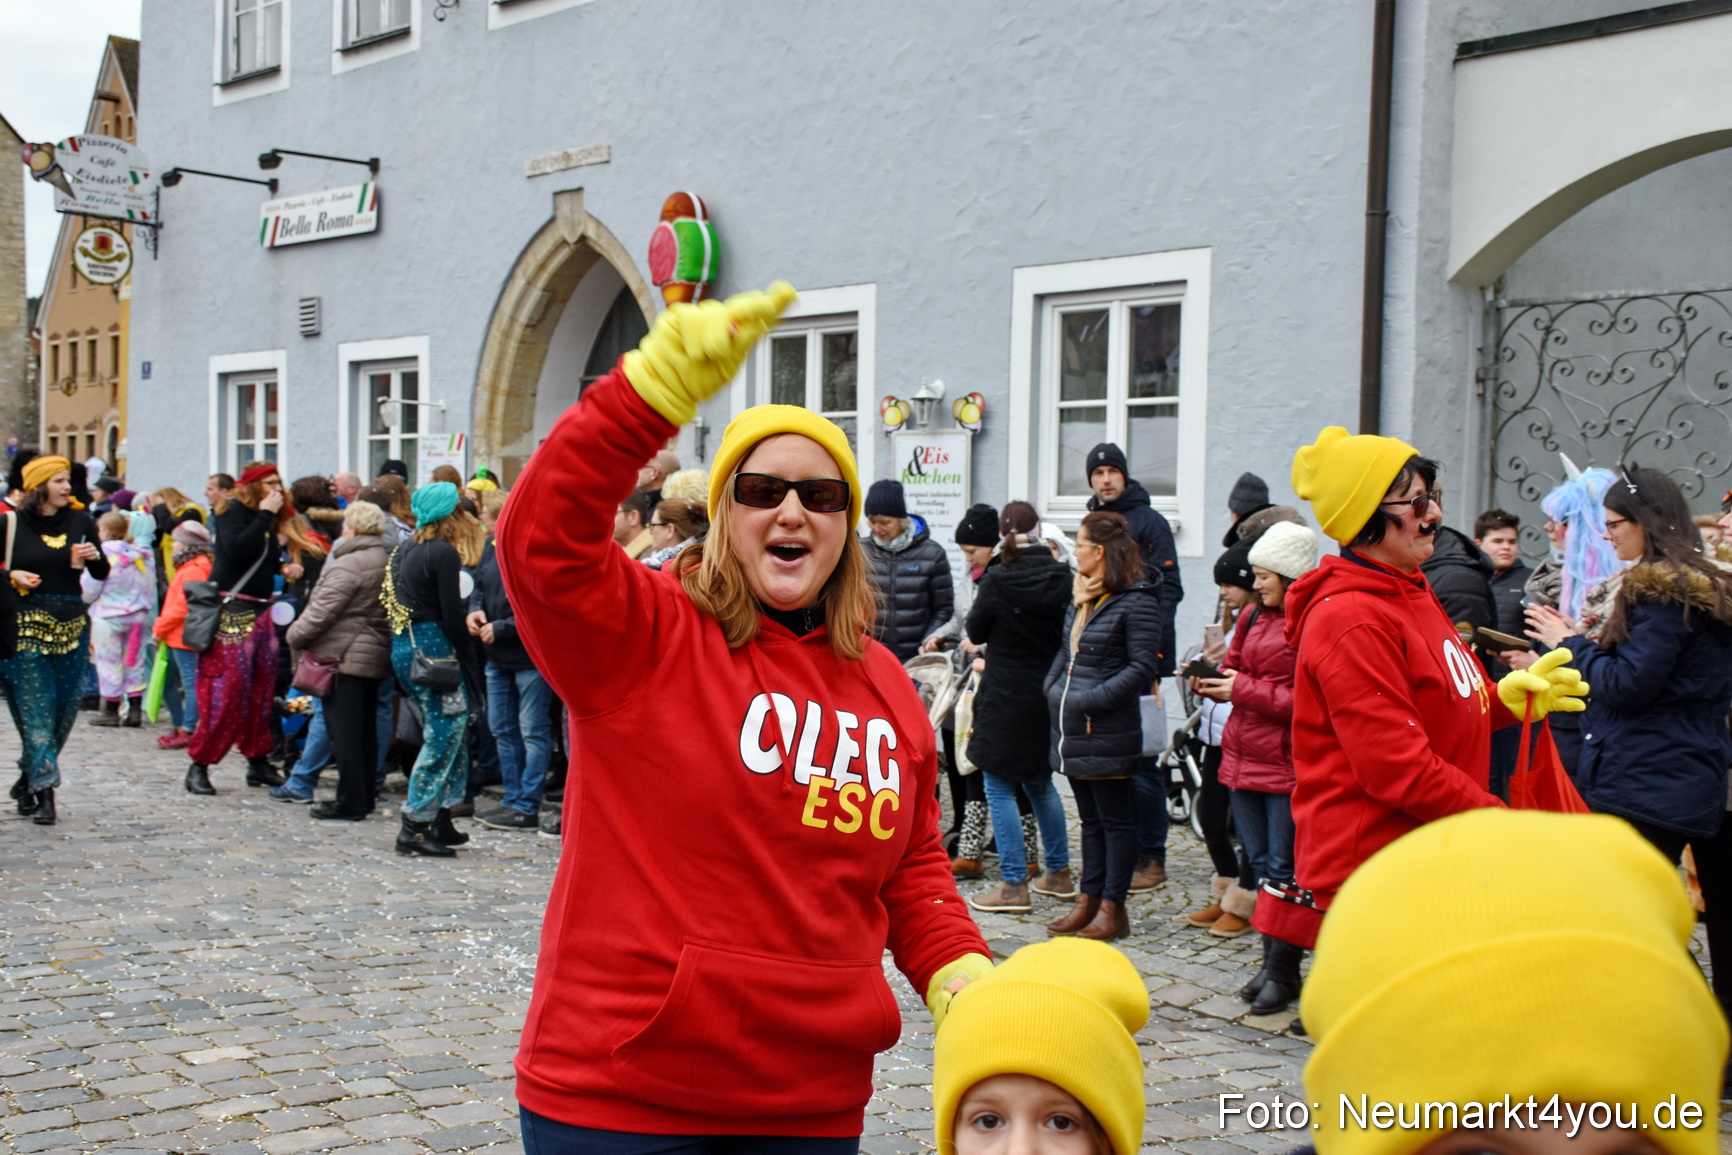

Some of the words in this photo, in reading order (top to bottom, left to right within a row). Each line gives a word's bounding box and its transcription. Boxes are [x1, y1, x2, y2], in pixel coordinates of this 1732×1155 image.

[78, 137, 128, 154] Pizzeria
[90, 155, 117, 168] Café
[76, 168, 129, 185] Eisdiele
[280, 215, 312, 239] Bella
[316, 211, 355, 233] Roma
[908, 445, 927, 477] &
[922, 447, 950, 464] Eis
[901, 468, 962, 485] Kuchen
[801, 774, 900, 840] ESC
